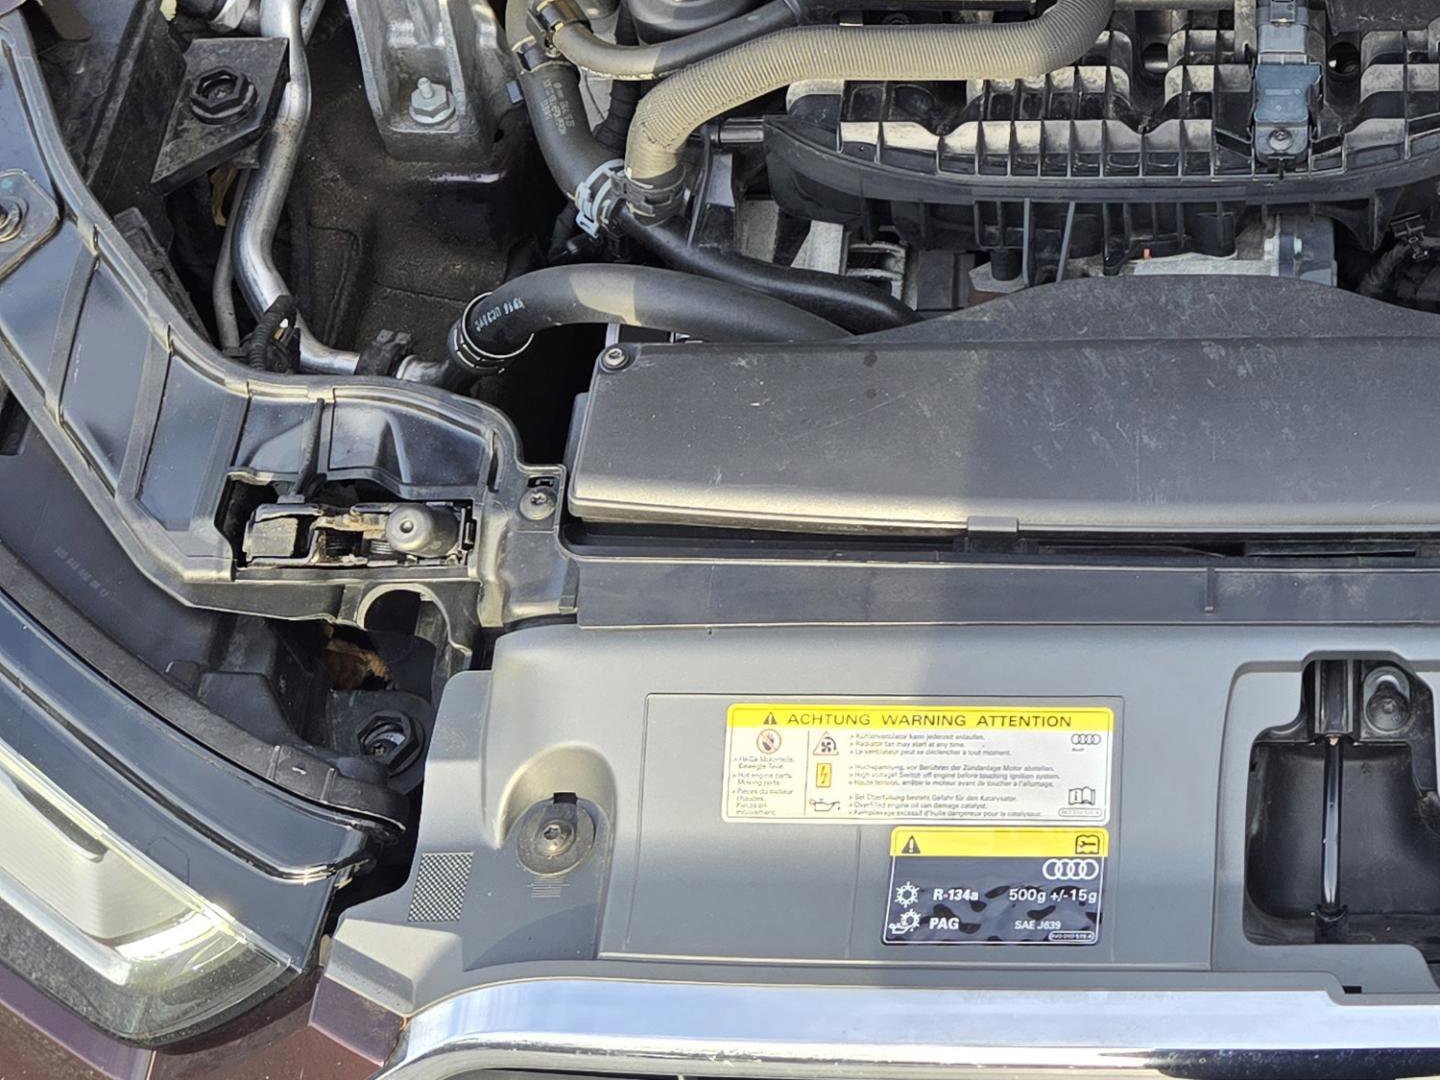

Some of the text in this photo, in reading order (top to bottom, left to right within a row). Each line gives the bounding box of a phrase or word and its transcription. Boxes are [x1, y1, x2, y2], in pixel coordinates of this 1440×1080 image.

[787, 713, 1072, 727] ACHTUNG WARNING ATTENTION
[932, 888, 1097, 904] R-134a 500g +/-15g
[929, 917, 960, 930] PAG
[1014, 920, 1061, 930] SAE J639
